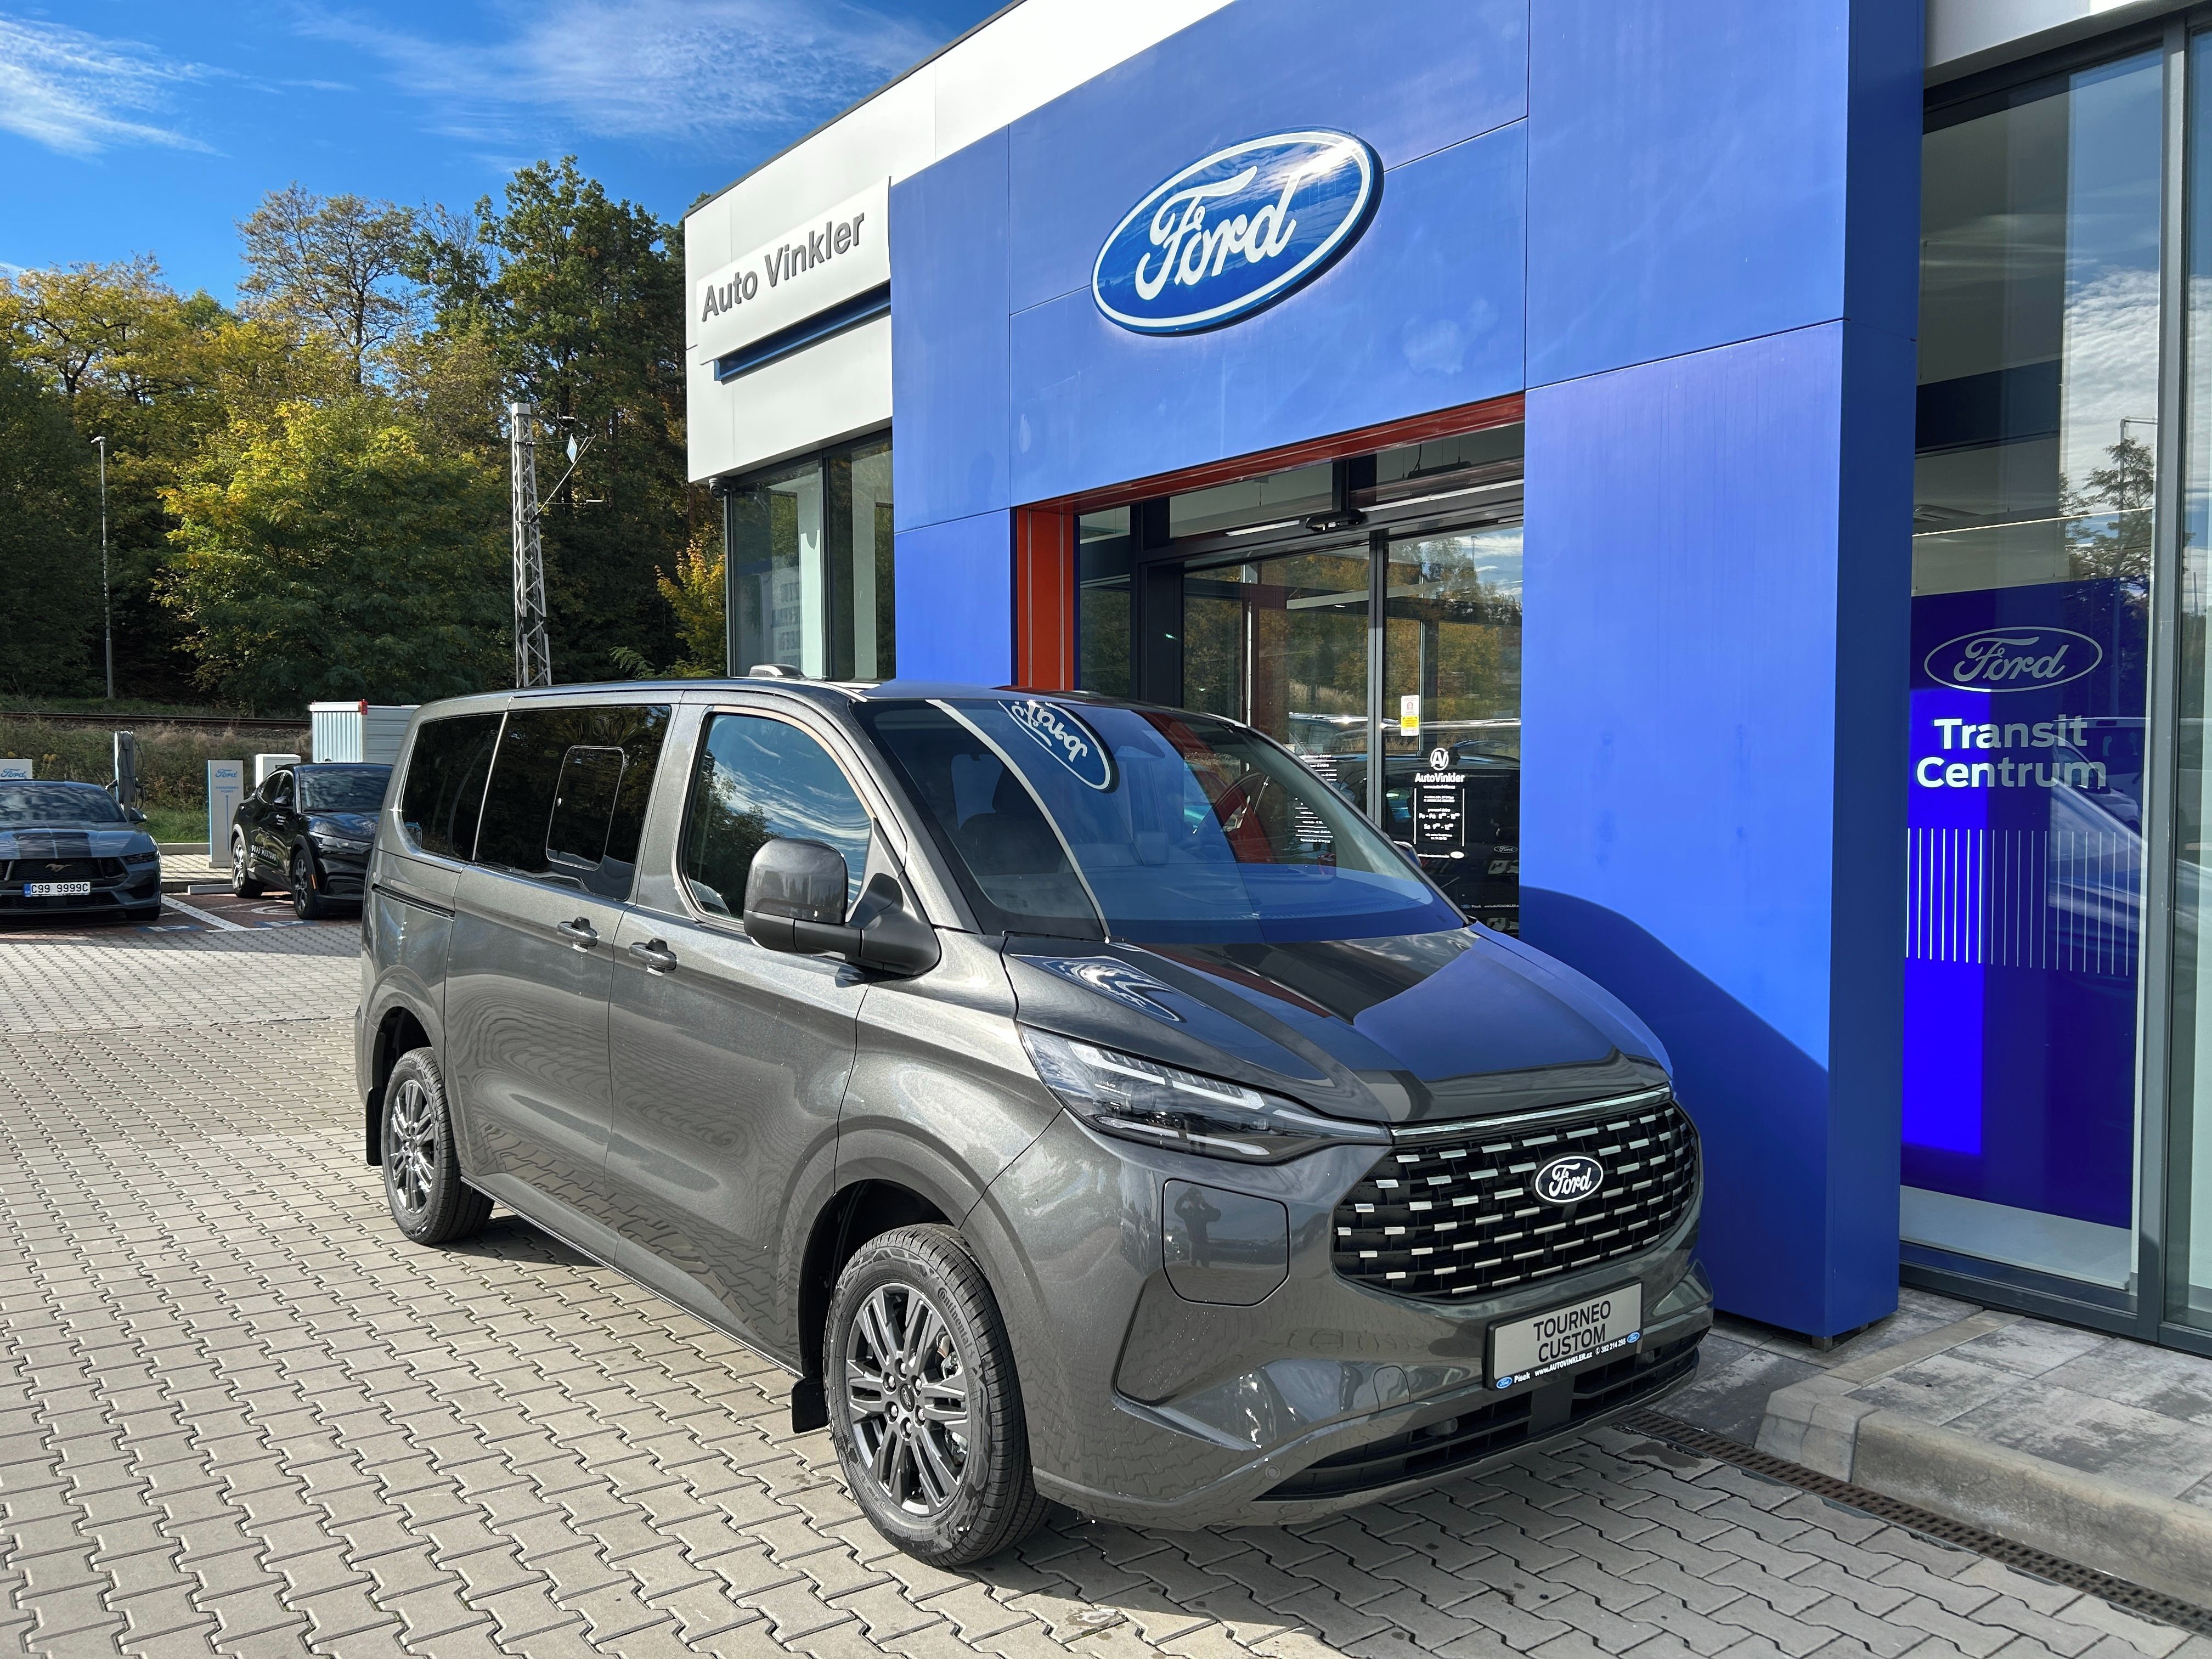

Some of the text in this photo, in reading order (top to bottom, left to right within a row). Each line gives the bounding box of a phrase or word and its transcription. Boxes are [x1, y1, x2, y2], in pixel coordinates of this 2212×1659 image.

[1135, 166, 1301, 300] Ford
[702, 212, 865, 322] Auto Vinkler
[1953, 636, 2069, 682] Ford
[1934, 714, 2087, 749] Transit
[1, 769, 26, 778] Ford
[216, 769, 238, 777] Ford
[1414, 772, 1465, 782] AutoVinkler
[1917, 757, 2106, 787] Centrum
[31, 883, 88, 893] C99 9999C
[1549, 1163, 1592, 1197] Ford
[937, 1287, 973, 1349] Continental
[1533, 1300, 1611, 1341] TOURNEO
[1538, 1323, 1606, 1362] CUSTOM
